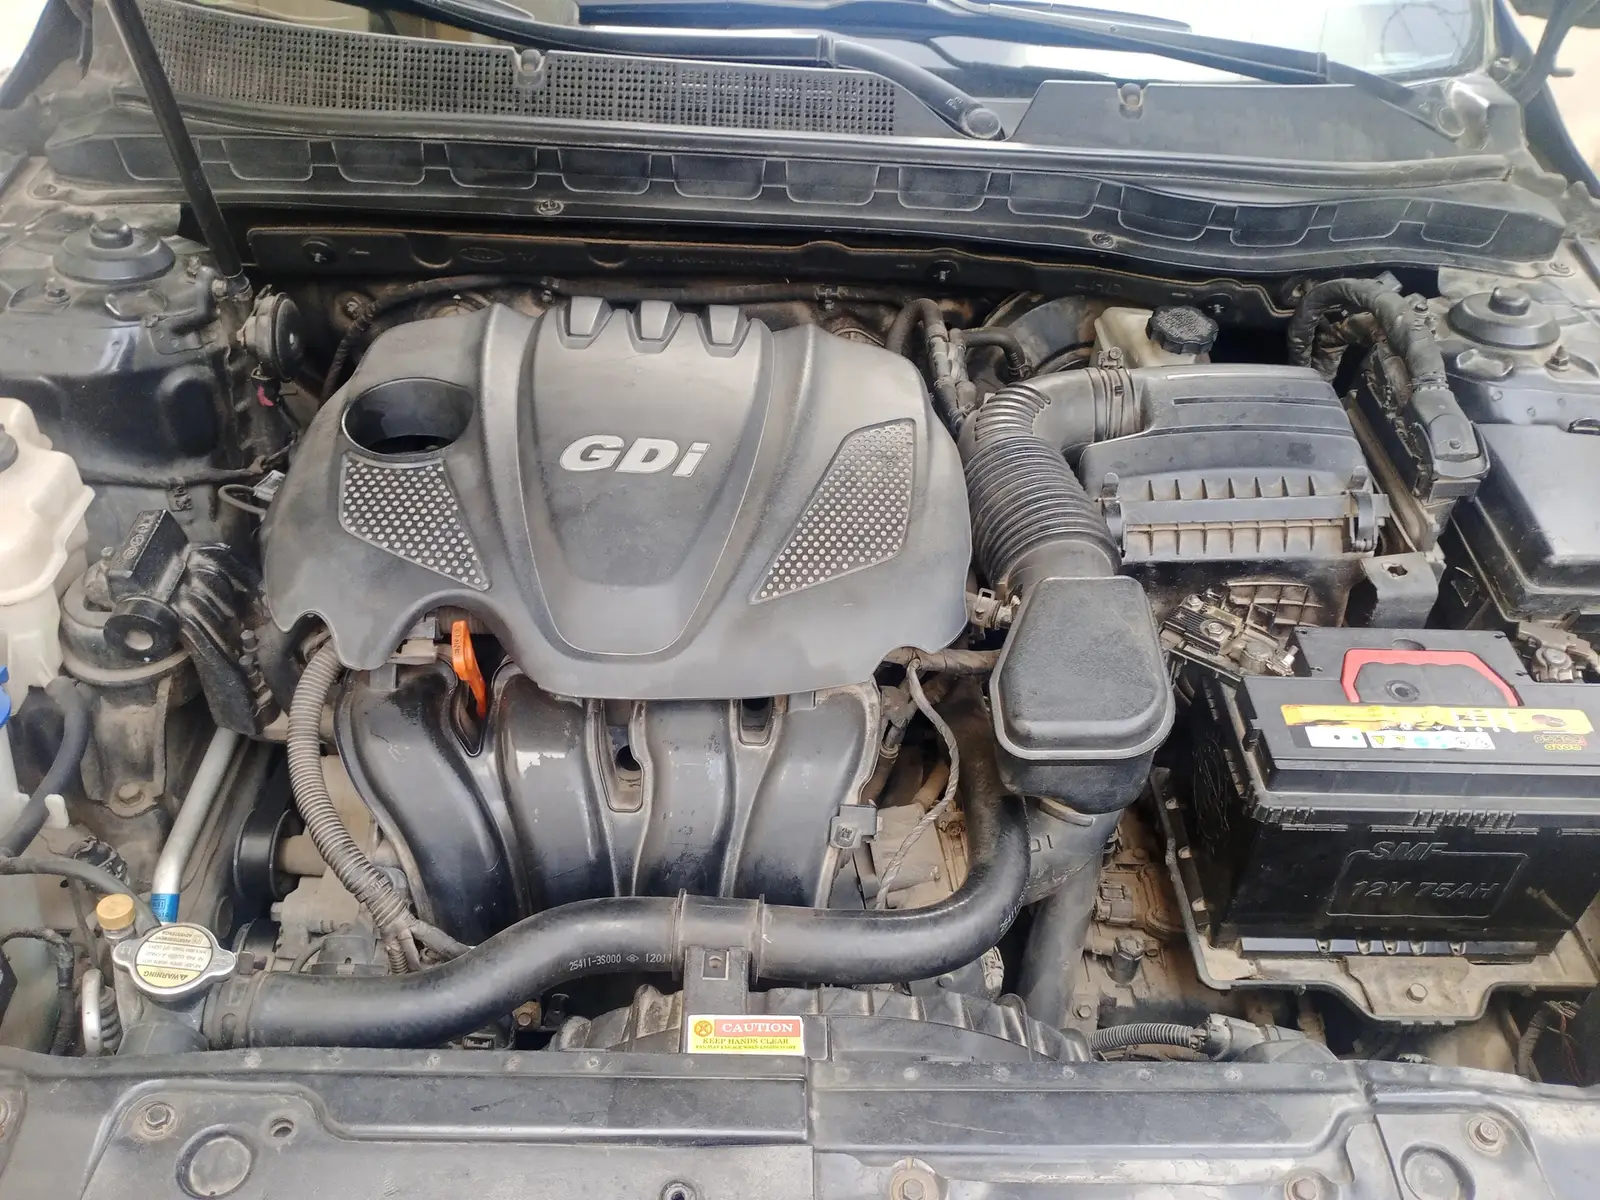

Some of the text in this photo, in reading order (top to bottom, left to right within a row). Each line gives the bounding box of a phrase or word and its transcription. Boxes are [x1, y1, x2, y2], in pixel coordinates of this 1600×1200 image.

[559, 434, 711, 478] GDi
[1370, 840, 1449, 861] SMF
[1352, 881, 1499, 899] 12V 75AH
[568, 953, 622, 971] 25411-3S000
[143, 971, 180, 980] WARNING
[722, 1023, 794, 1033] CAUTION
